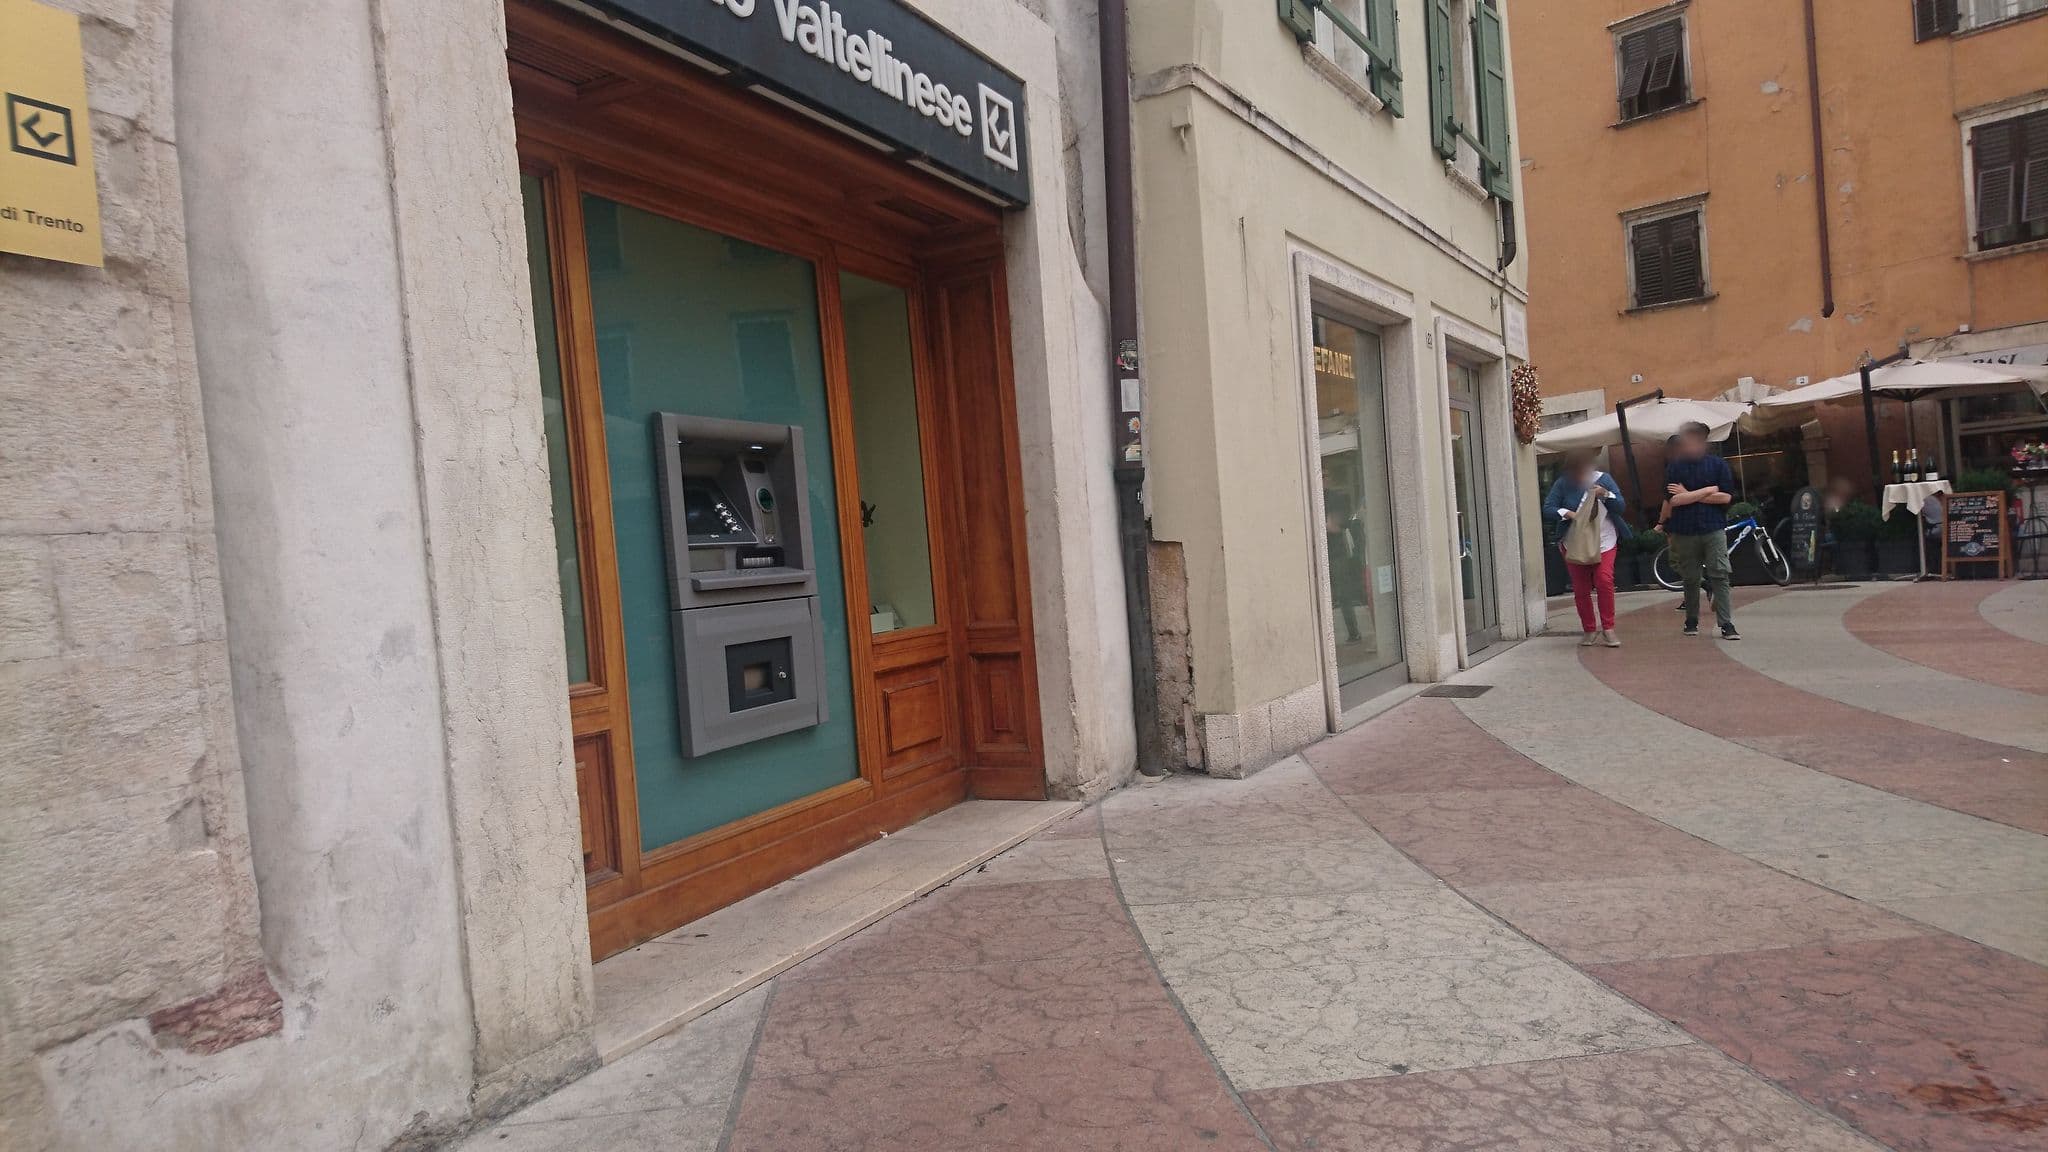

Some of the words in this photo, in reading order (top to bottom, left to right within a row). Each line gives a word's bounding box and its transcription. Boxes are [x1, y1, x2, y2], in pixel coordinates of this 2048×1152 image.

[773, 0, 973, 137] Valtellinese
[0, 206, 18, 221] di
[23, 209, 84, 233] Trento
